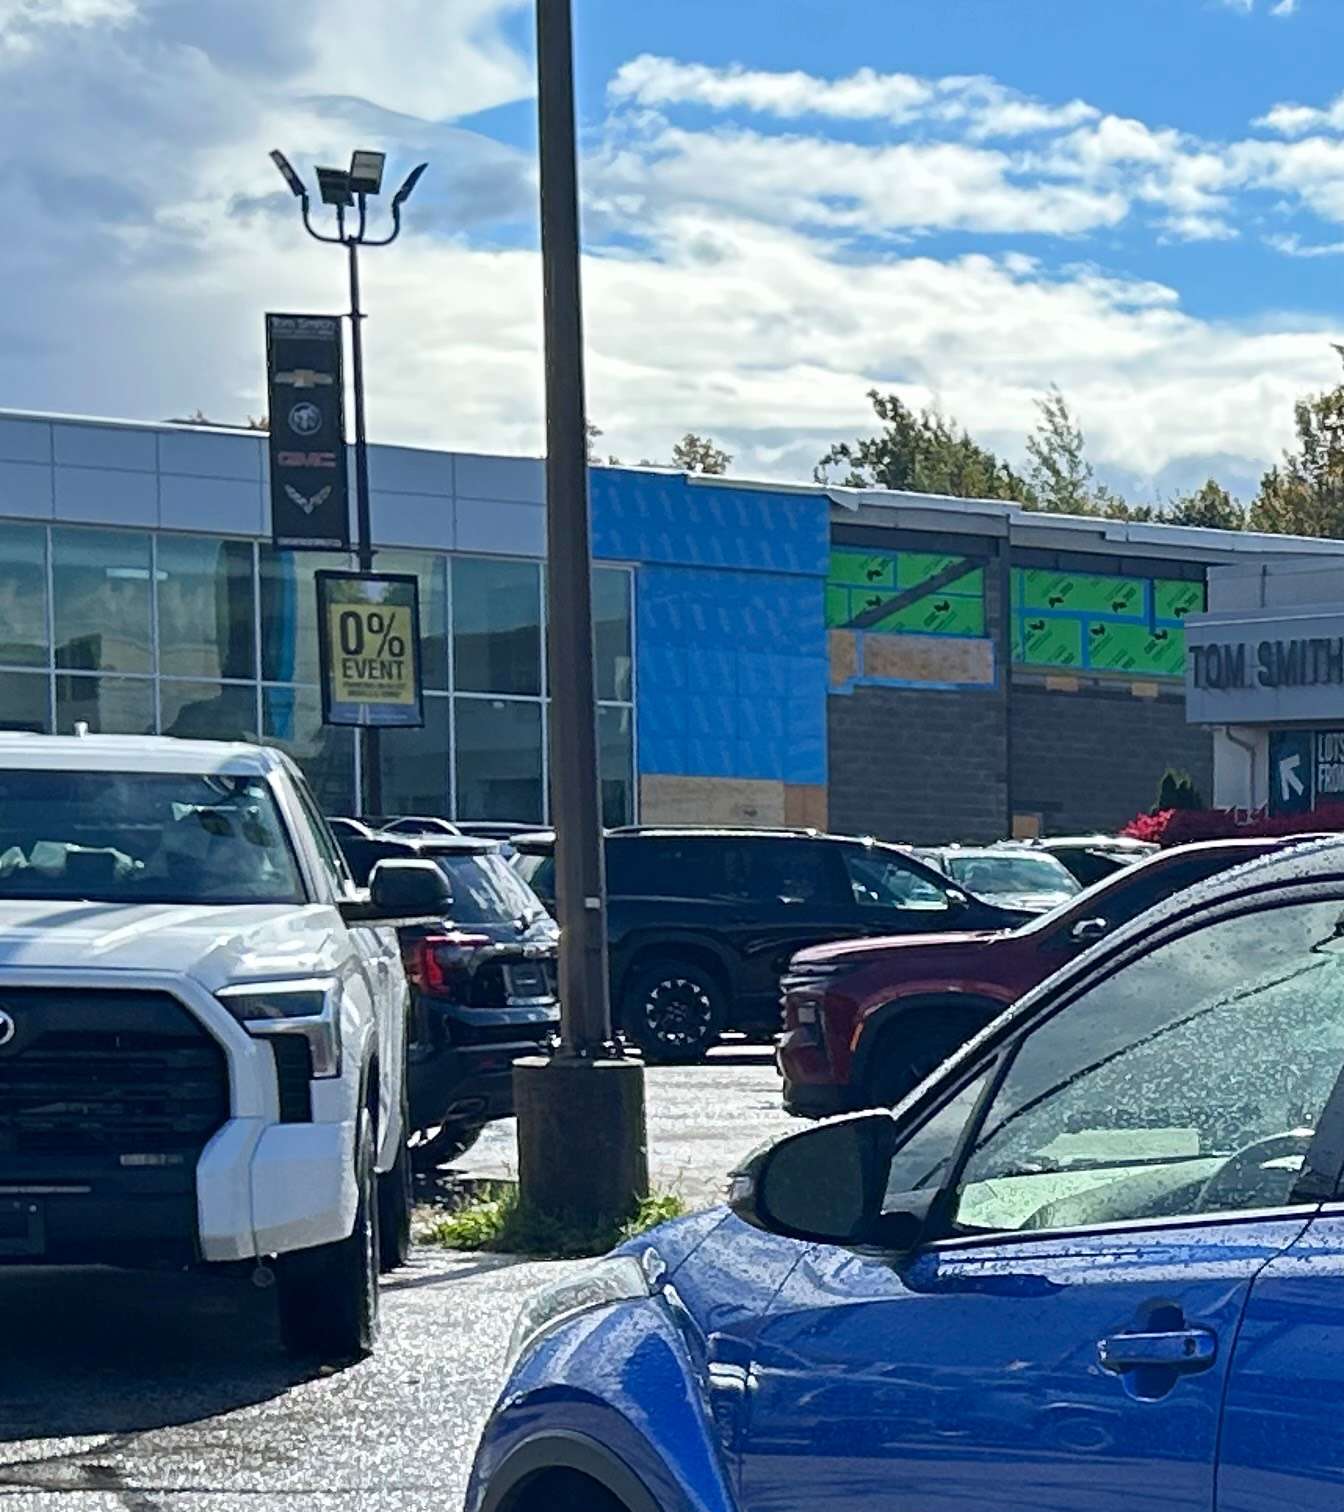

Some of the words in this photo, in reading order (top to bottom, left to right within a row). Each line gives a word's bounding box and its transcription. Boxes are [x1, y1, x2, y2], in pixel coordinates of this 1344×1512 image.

[340, 611, 405, 658] 0%
[341, 658, 405, 680] EVENT
[1189, 643, 1246, 689] TOM
[1257, 636, 1344, 688] SMITH
